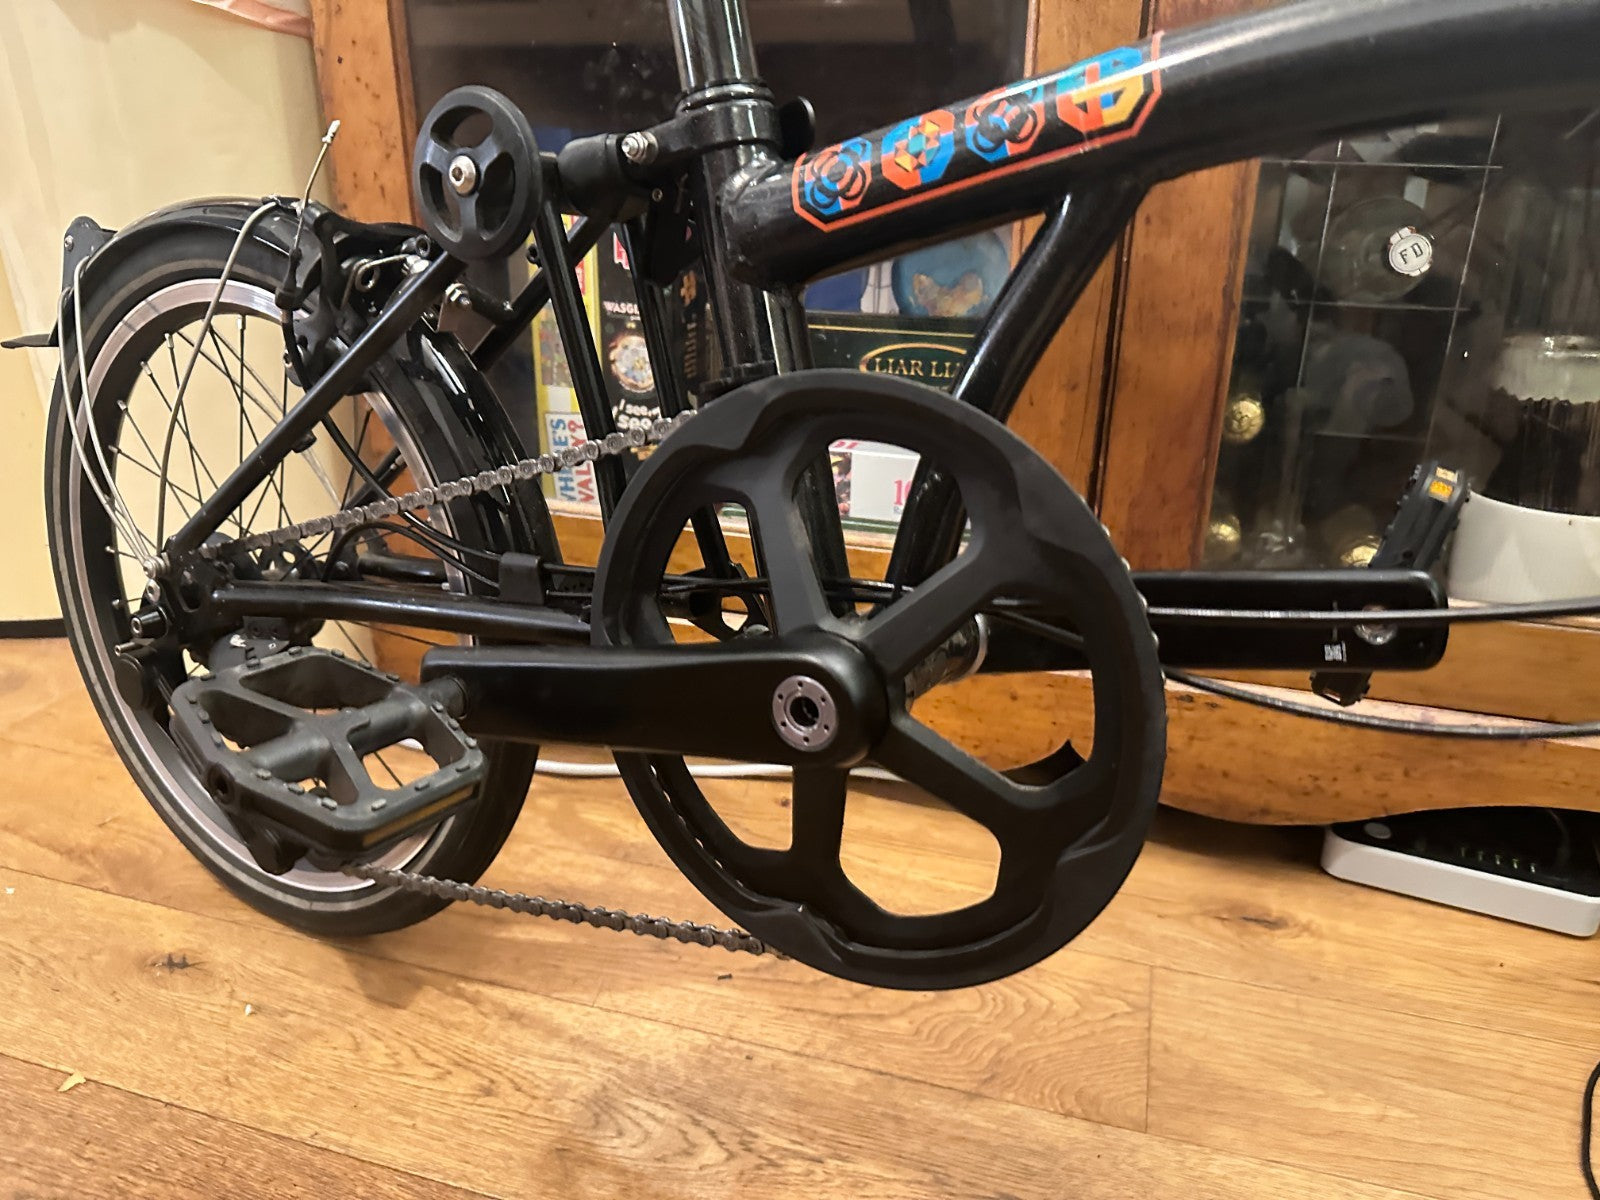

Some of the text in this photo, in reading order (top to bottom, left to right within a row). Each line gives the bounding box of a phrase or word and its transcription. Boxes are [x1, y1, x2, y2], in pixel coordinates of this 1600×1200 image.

[603, 301, 640, 315] WASGI
[874, 358, 961, 378] LIAR LI
